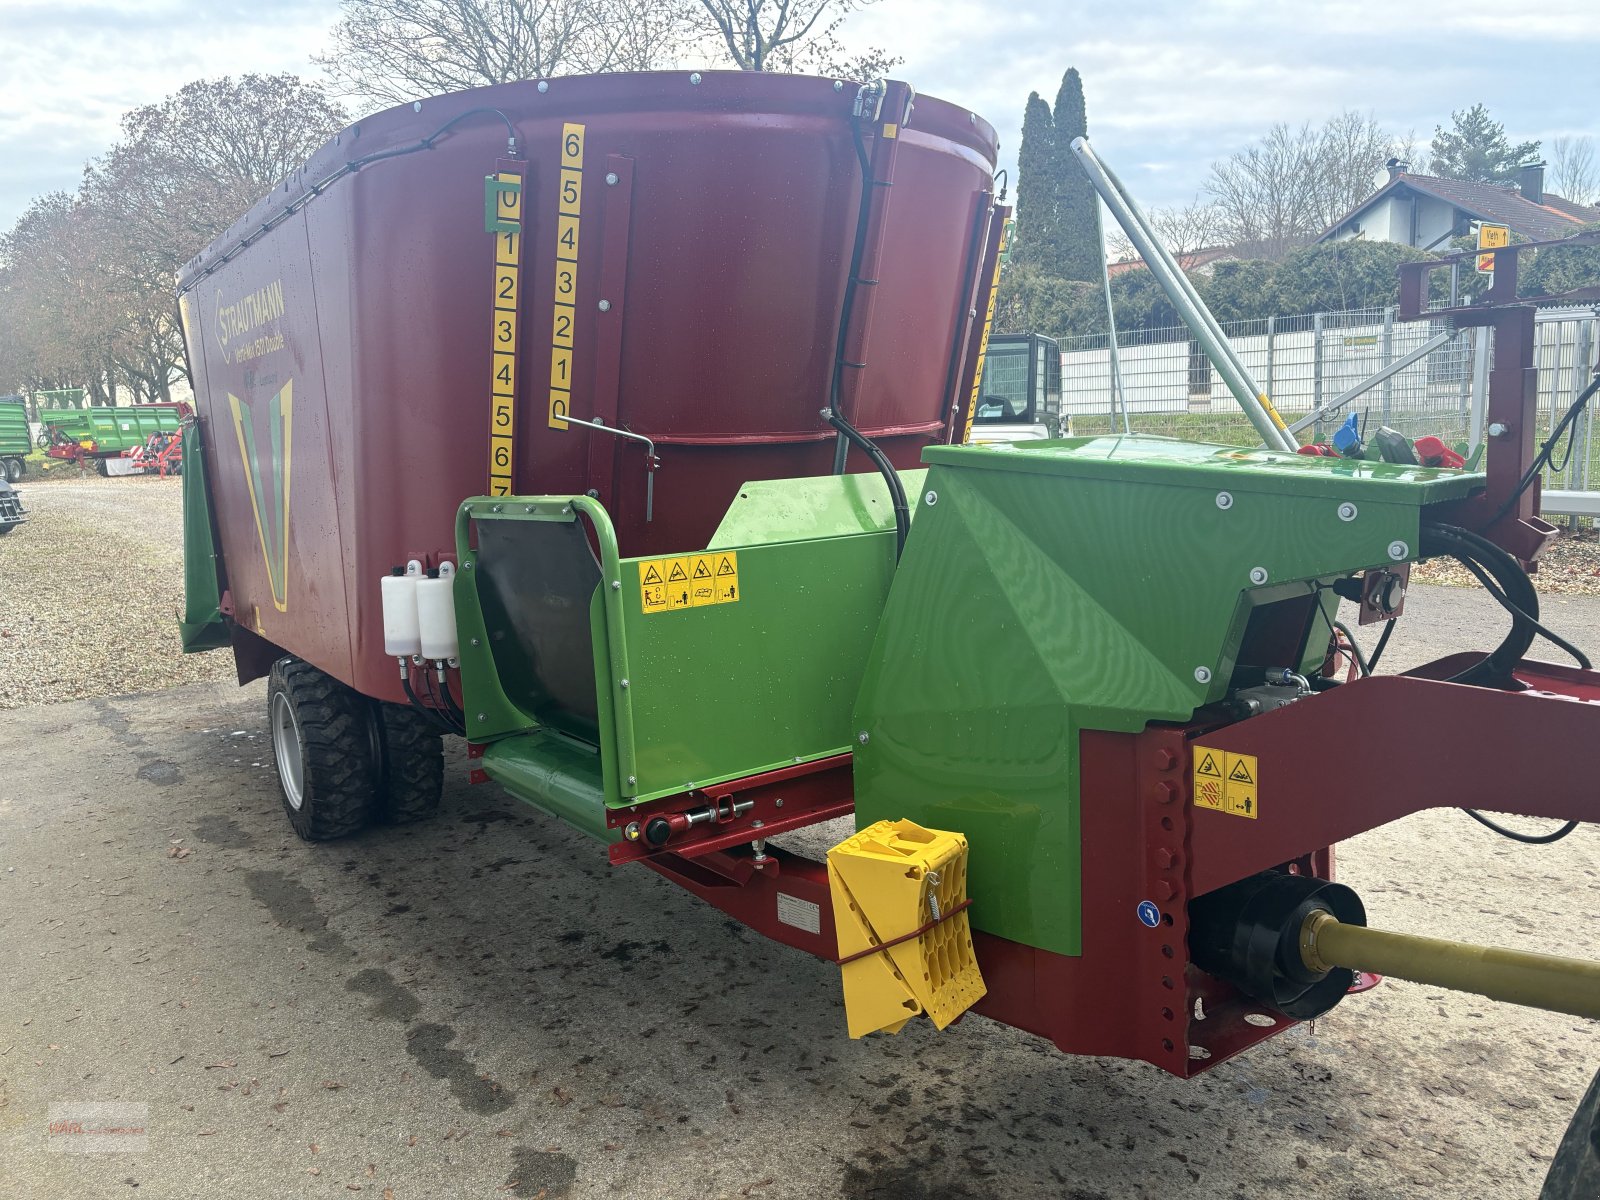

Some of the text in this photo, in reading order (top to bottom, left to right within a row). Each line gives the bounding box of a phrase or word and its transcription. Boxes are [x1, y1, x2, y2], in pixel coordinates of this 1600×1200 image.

[565, 133, 580, 158] 6
[502, 191, 517, 208] 0
[562, 179, 578, 204] 5
[503, 232, 514, 255] 1
[560, 226, 576, 250] 4
[498, 276, 515, 300] 2
[558, 271, 573, 294] 3
[219, 279, 285, 346] STRAUTMANN
[497, 320, 513, 343] 3
[555, 315, 571, 339] 2
[983, 330, 989, 346] 3
[496, 363, 512, 386] 4
[557, 358, 567, 380] 1
[495, 405, 511, 427] 5
[552, 399, 566, 419] 0
[494, 446, 509, 467] 6
